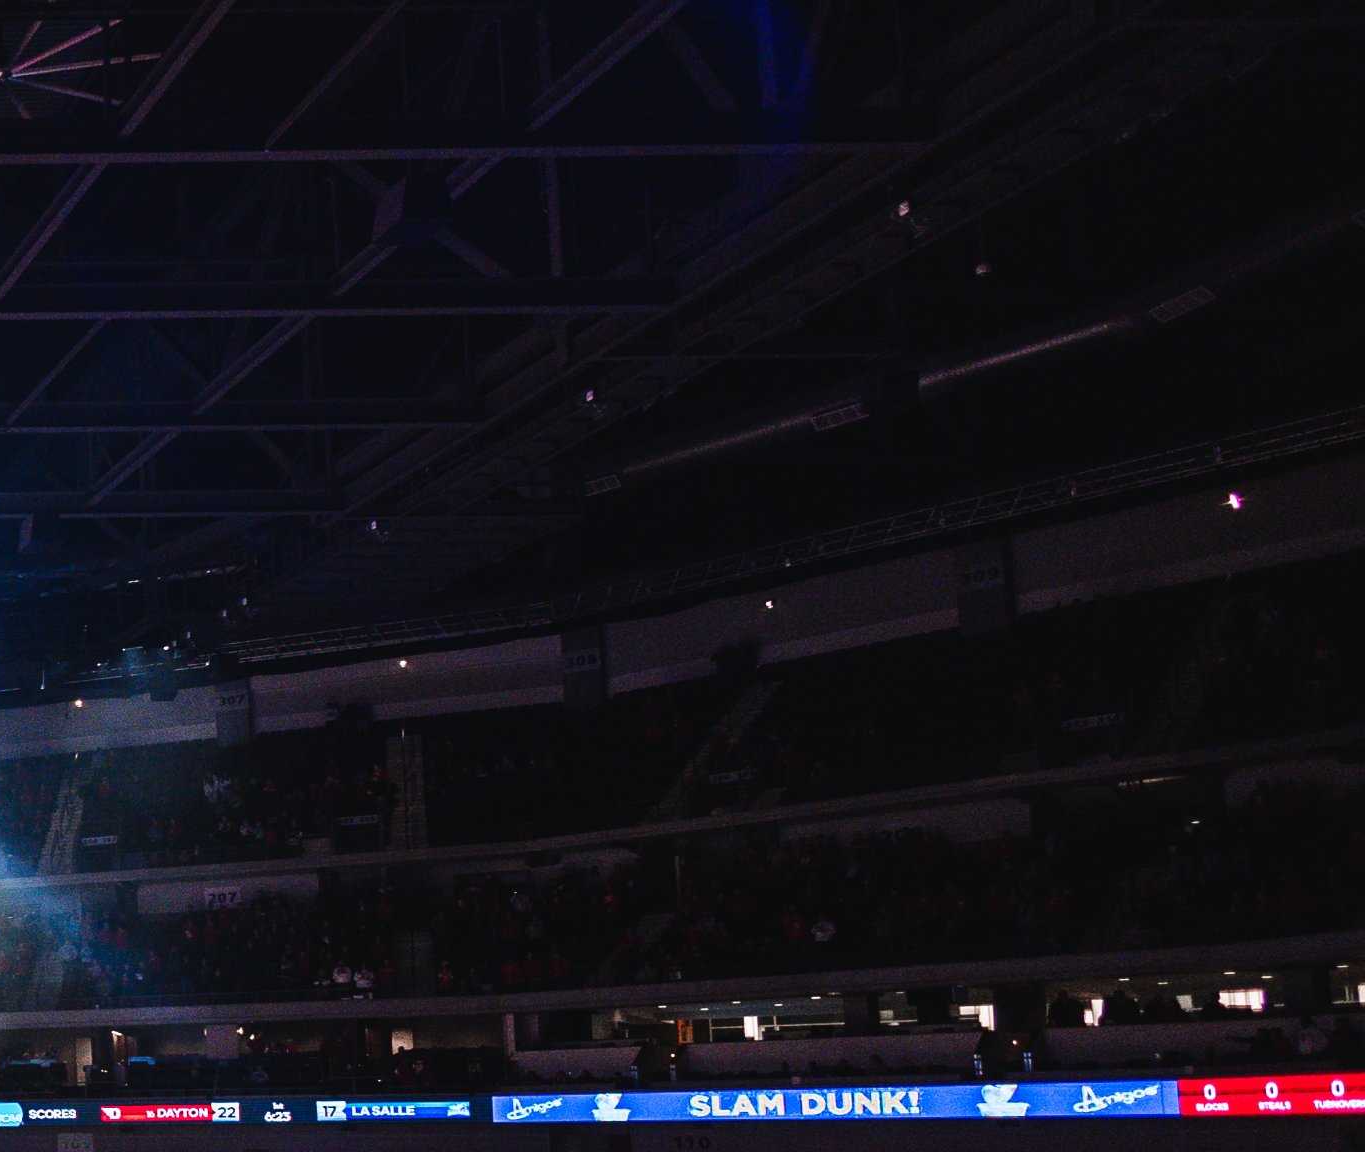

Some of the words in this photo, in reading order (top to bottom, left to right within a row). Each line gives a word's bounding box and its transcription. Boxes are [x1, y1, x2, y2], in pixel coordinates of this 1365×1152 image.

[1204, 1084, 1216, 1100] 0
[1265, 1082, 1278, 1098] 0
[688, 1092, 786, 1118] SLAM
[799, 1090, 921, 1117] DUNK!
[1072, 1083, 1162, 1114] Amigos
[157, 1108, 208, 1118] DAYTON
[218, 1106, 237, 1119] 22
[322, 1105, 337, 1118] 17
[350, 1104, 371, 1117] LA
[372, 1104, 416, 1117] SALLE
[1196, 1103, 1229, 1111] BLOCKS
[1259, 1101, 1291, 1110] STEALS
[29, 1109, 76, 1119] SCORES
[265, 1112, 291, 1121] 6:23
